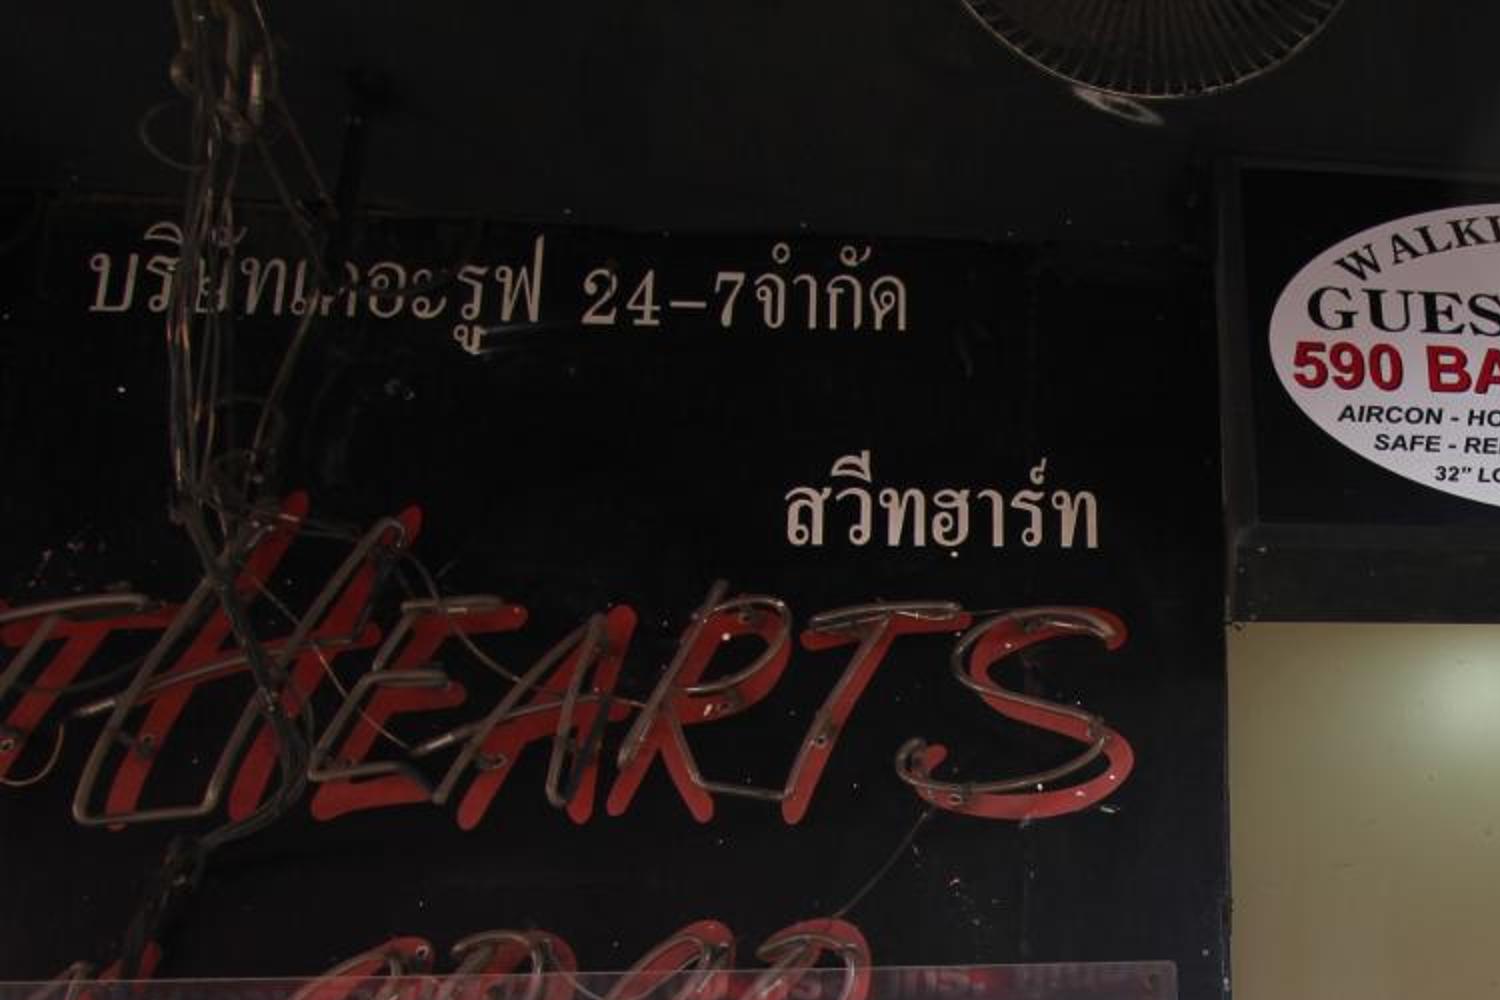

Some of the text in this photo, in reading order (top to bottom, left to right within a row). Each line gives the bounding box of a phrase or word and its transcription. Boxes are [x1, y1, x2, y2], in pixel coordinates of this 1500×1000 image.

[1292, 340, 1404, 391] 590
[1338, 404, 1444, 425] AIRCON
[1374, 432, 1440, 453] SAFE
[783, 447, 1101, 559] สวีทฮาร์ท
